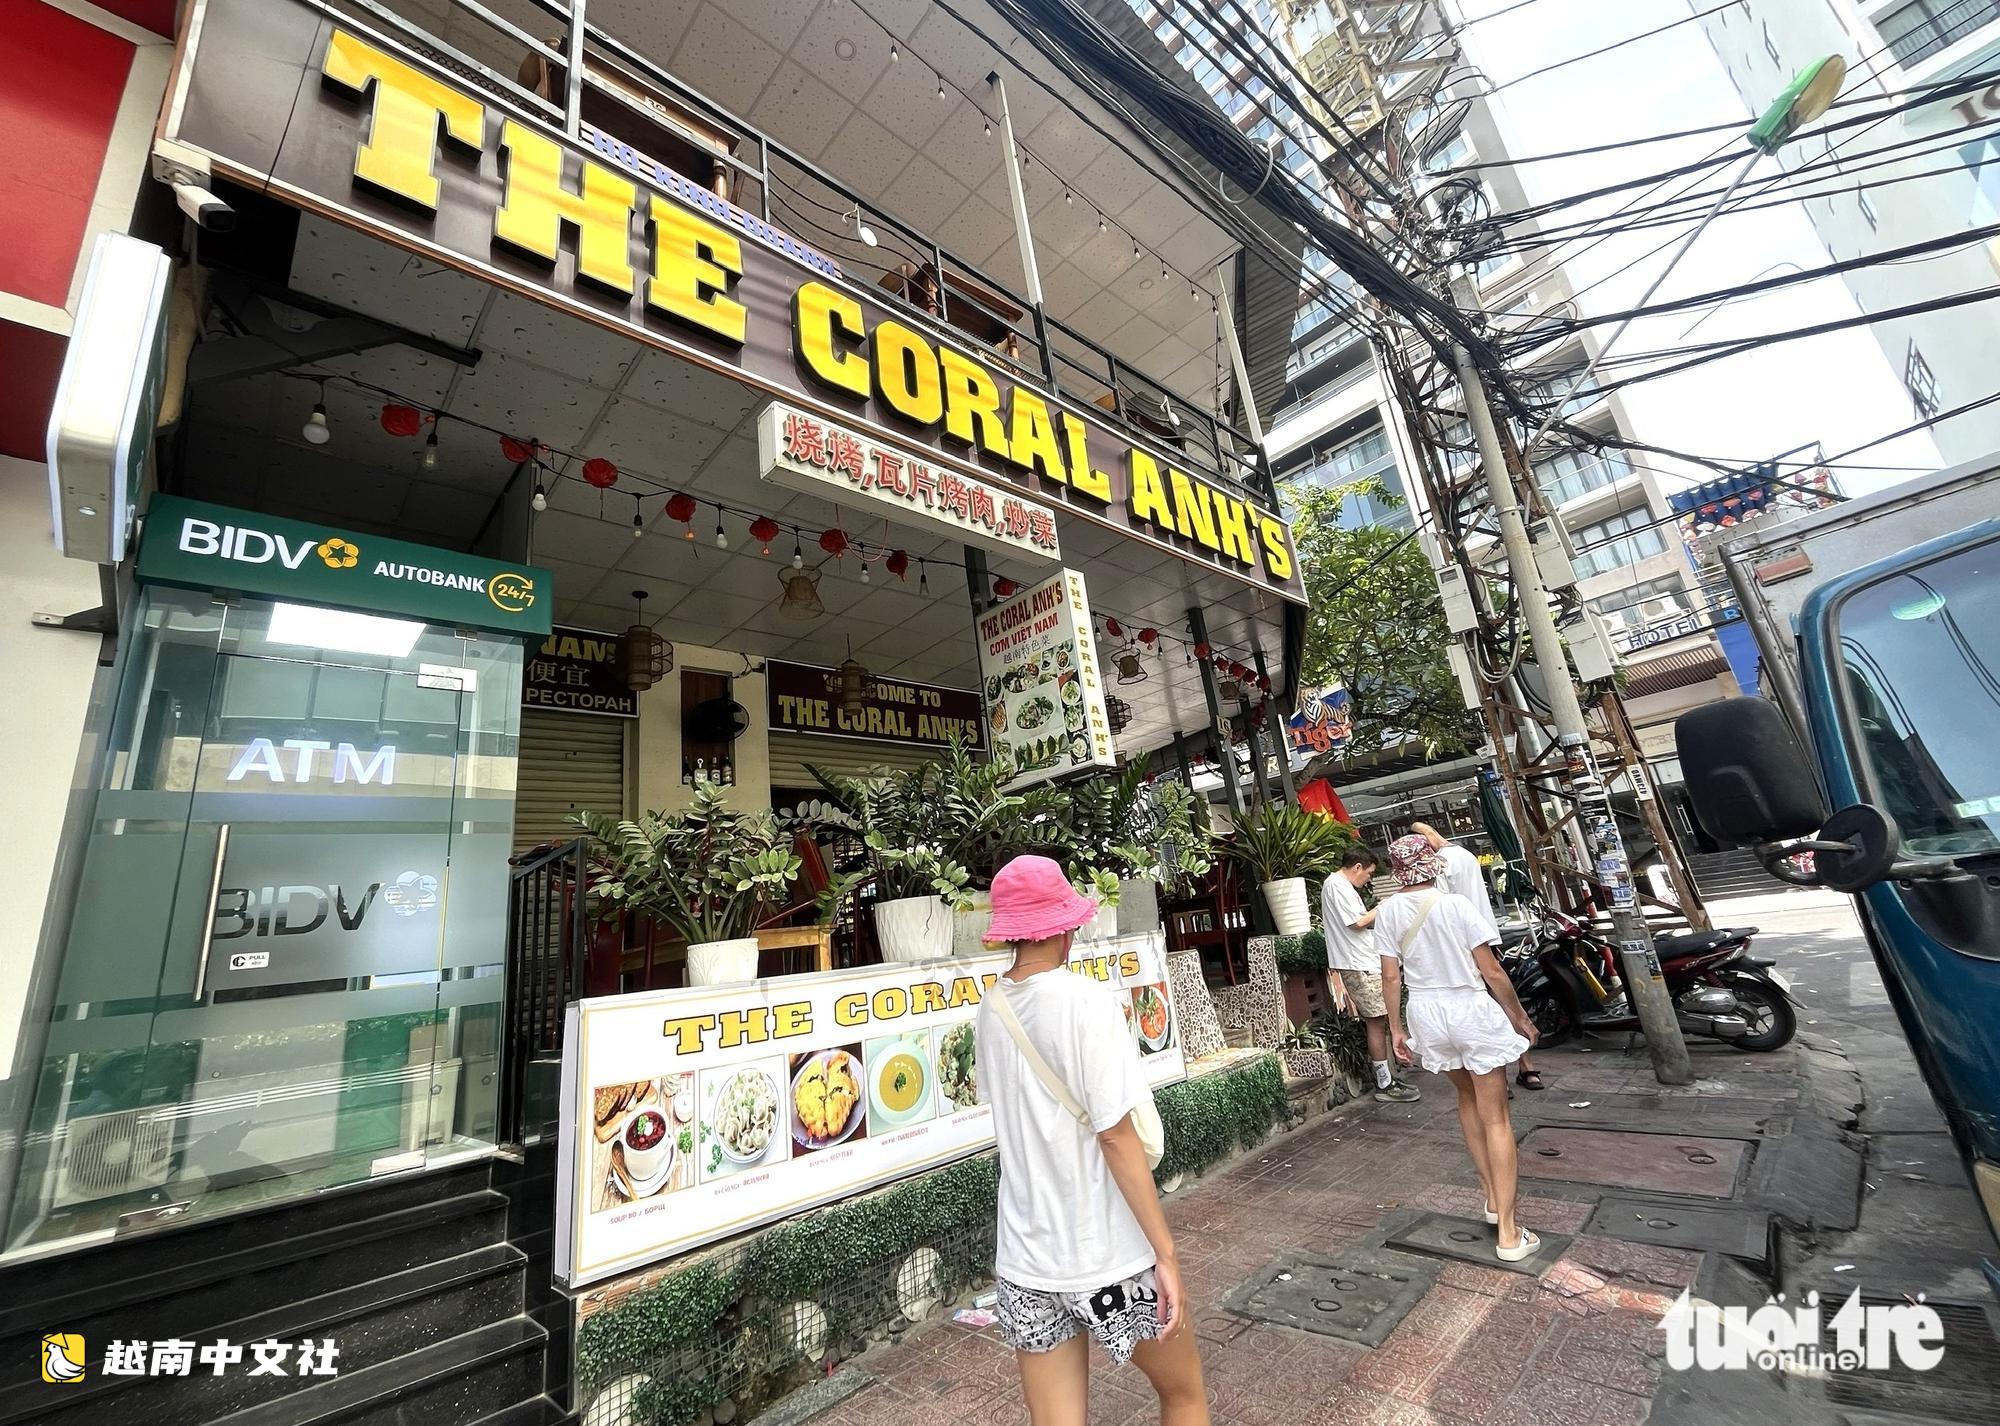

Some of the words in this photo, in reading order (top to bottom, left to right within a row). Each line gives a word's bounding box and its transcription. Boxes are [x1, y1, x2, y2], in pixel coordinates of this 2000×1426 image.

[322, 27, 748, 345] THE
[793, 281, 1112, 505] CORAL
[1127, 447, 1293, 581] ANH'S
[178, 517, 319, 570] BIDV
[373, 560, 487, 594] AUTOBANK
[496, 583, 536, 608] 24/7
[980, 614, 1000, 642] THE
[1000, 599, 1032, 632] CORAL
[1031, 581, 1064, 617] ANH'S
[1010, 626, 1032, 646] VIỆT
[1033, 612, 1060, 635] NAM
[525, 658, 592, 688] 便宜
[1069, 576, 1083, 610] THE
[1078, 626, 1095, 688] CORAL
[1090, 704, 1109, 757] ANH'S
[525, 687, 632, 713] РЕСТОРАН
[778, 694, 830, 729] THE
[917, 713, 979, 744] ANH'S
[919, 691, 942, 708] TO
[1288, 719, 1353, 752] Tiger
[226, 737, 397, 785] ATM
[213, 881, 387, 940] BIDV
[662, 1000, 814, 1055] THE
